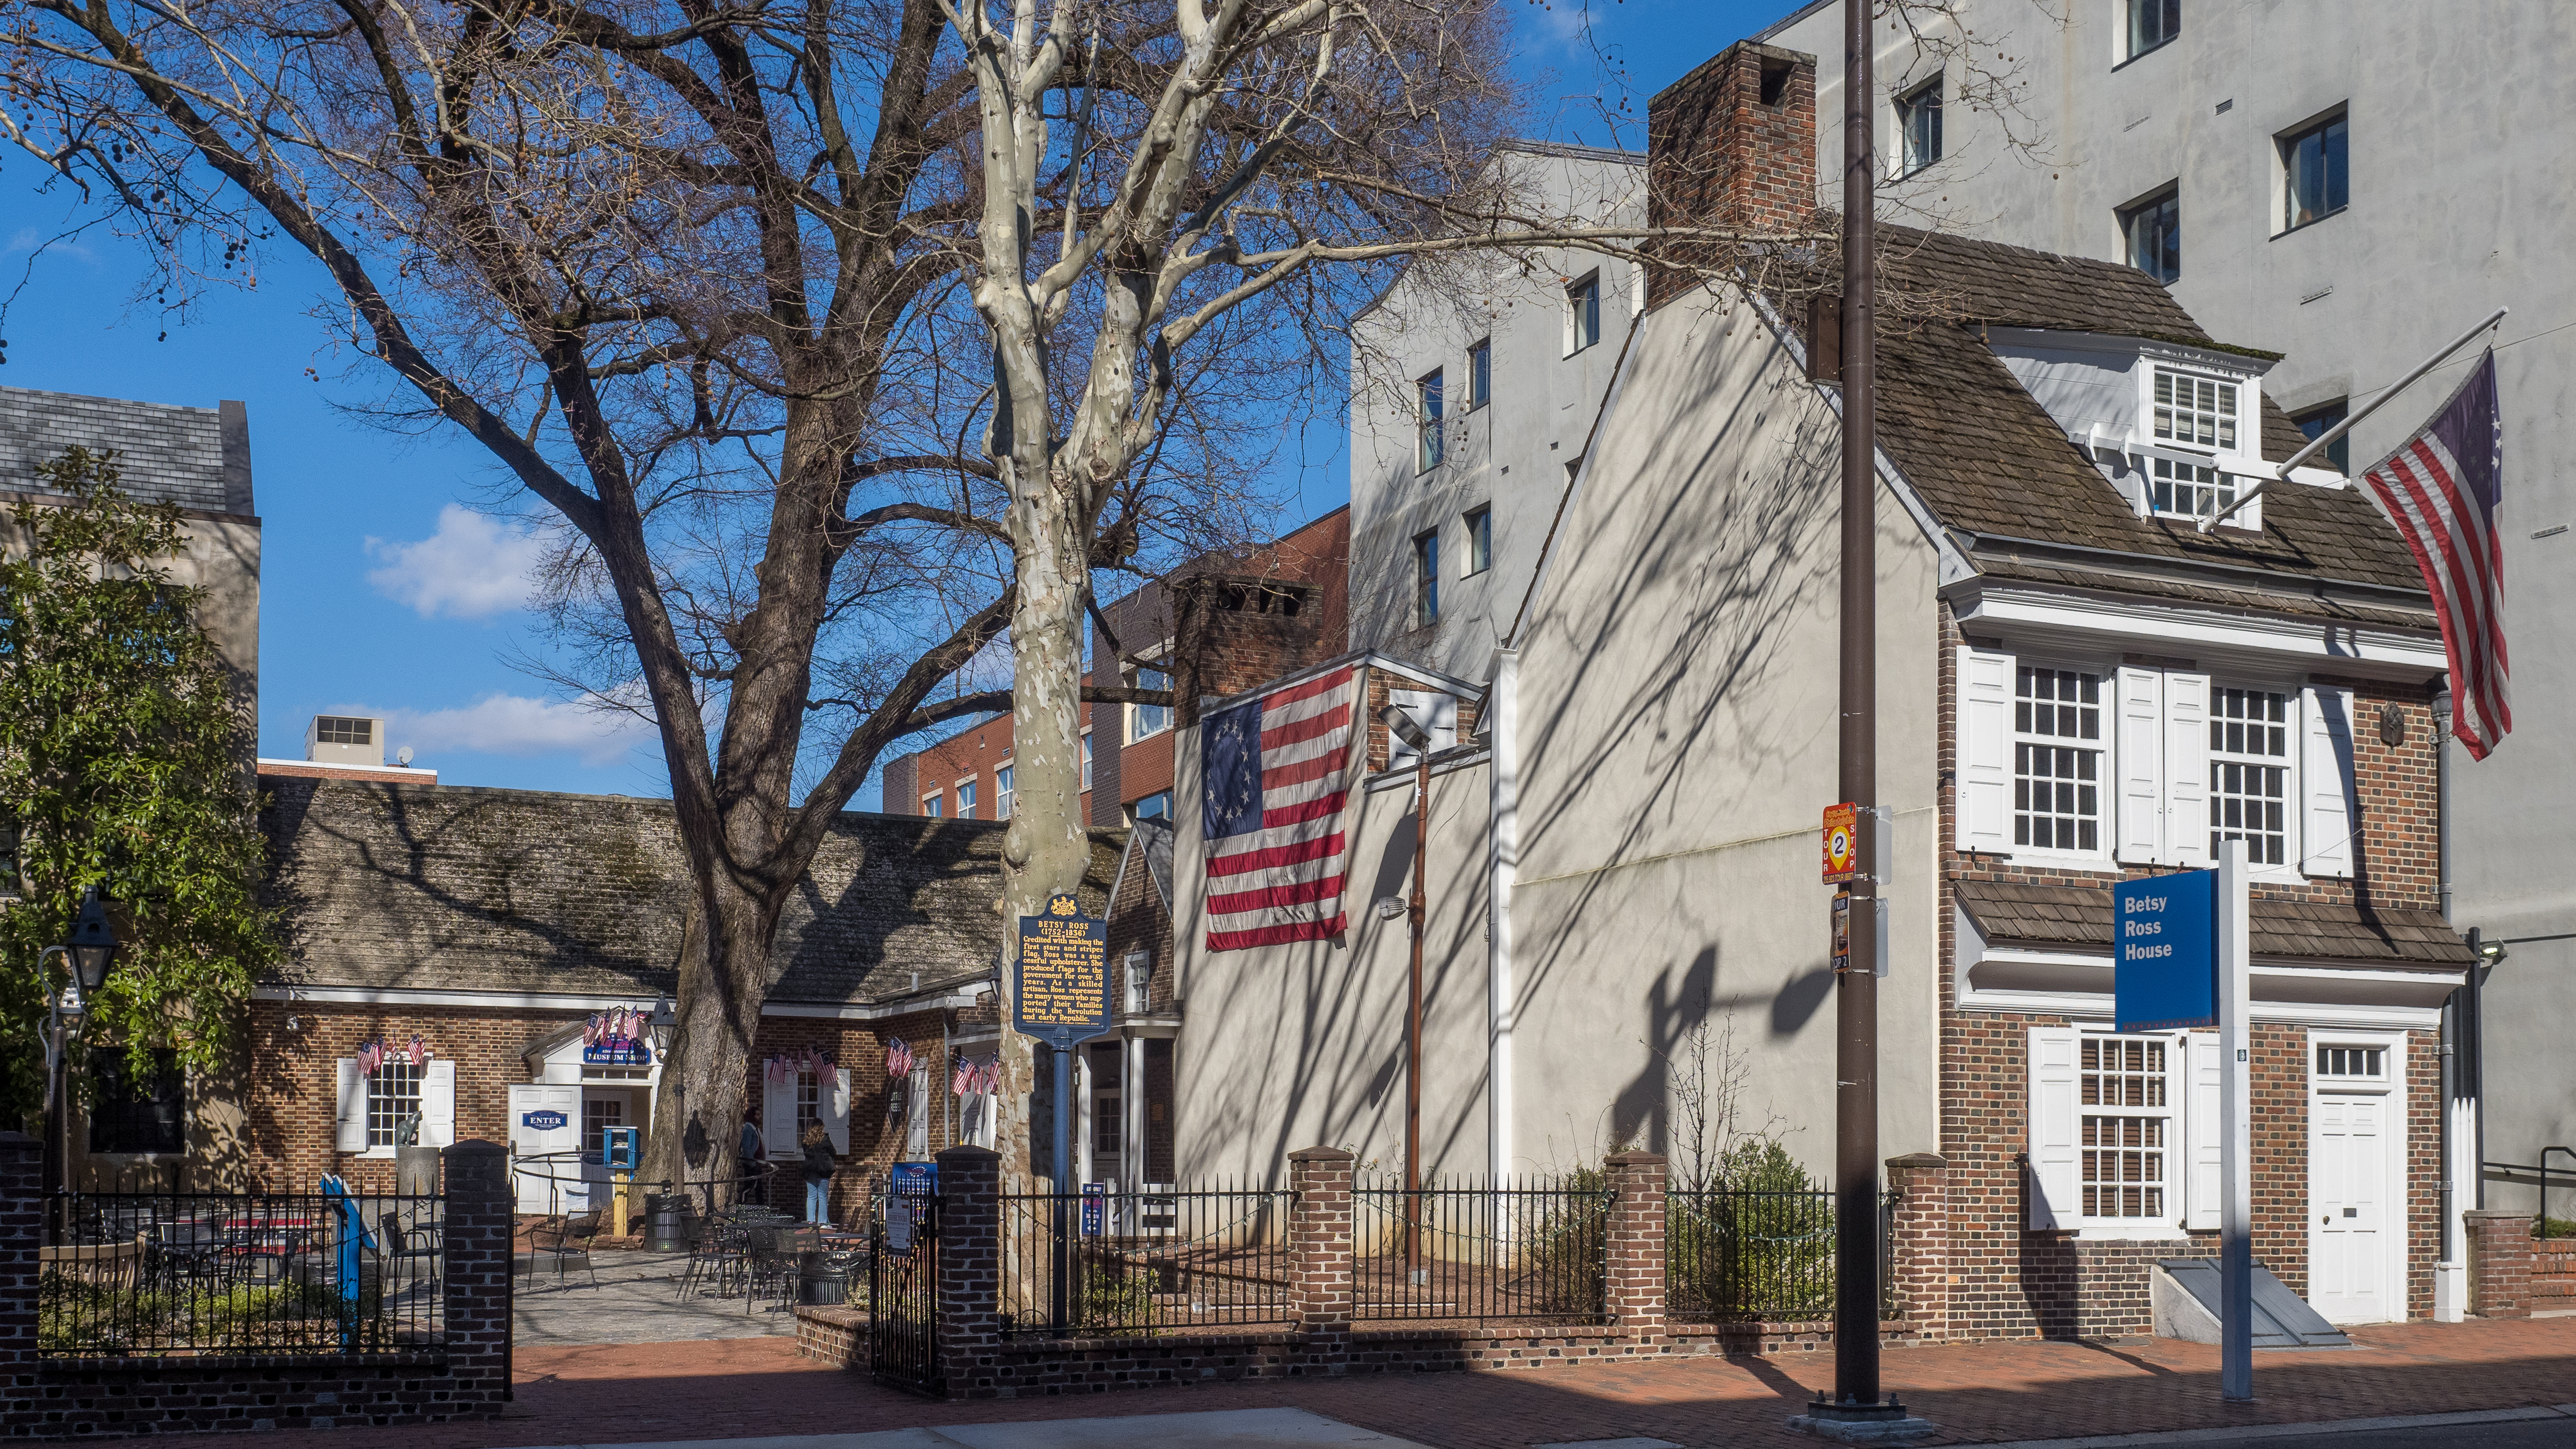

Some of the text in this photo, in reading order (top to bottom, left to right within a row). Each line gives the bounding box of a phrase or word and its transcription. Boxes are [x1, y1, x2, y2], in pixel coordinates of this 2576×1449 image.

[1835, 836, 1843, 854] 2
[2125, 895, 2167, 914] Betsy
[2125, 920, 2162, 937] Ross
[1069, 937, 1092, 946] making
[2125, 944, 2172, 961] House
[1049, 958, 1089, 966] upholsterer.
[1843, 956, 1848, 966] 2
[1058, 965, 1075, 974] flags
[1035, 993, 1052, 1001] many
[1022, 1007, 1046, 1015] during
[1067, 1008, 1103, 1016] Revolution
[1059, 1014, 1090, 1022] Republic.
